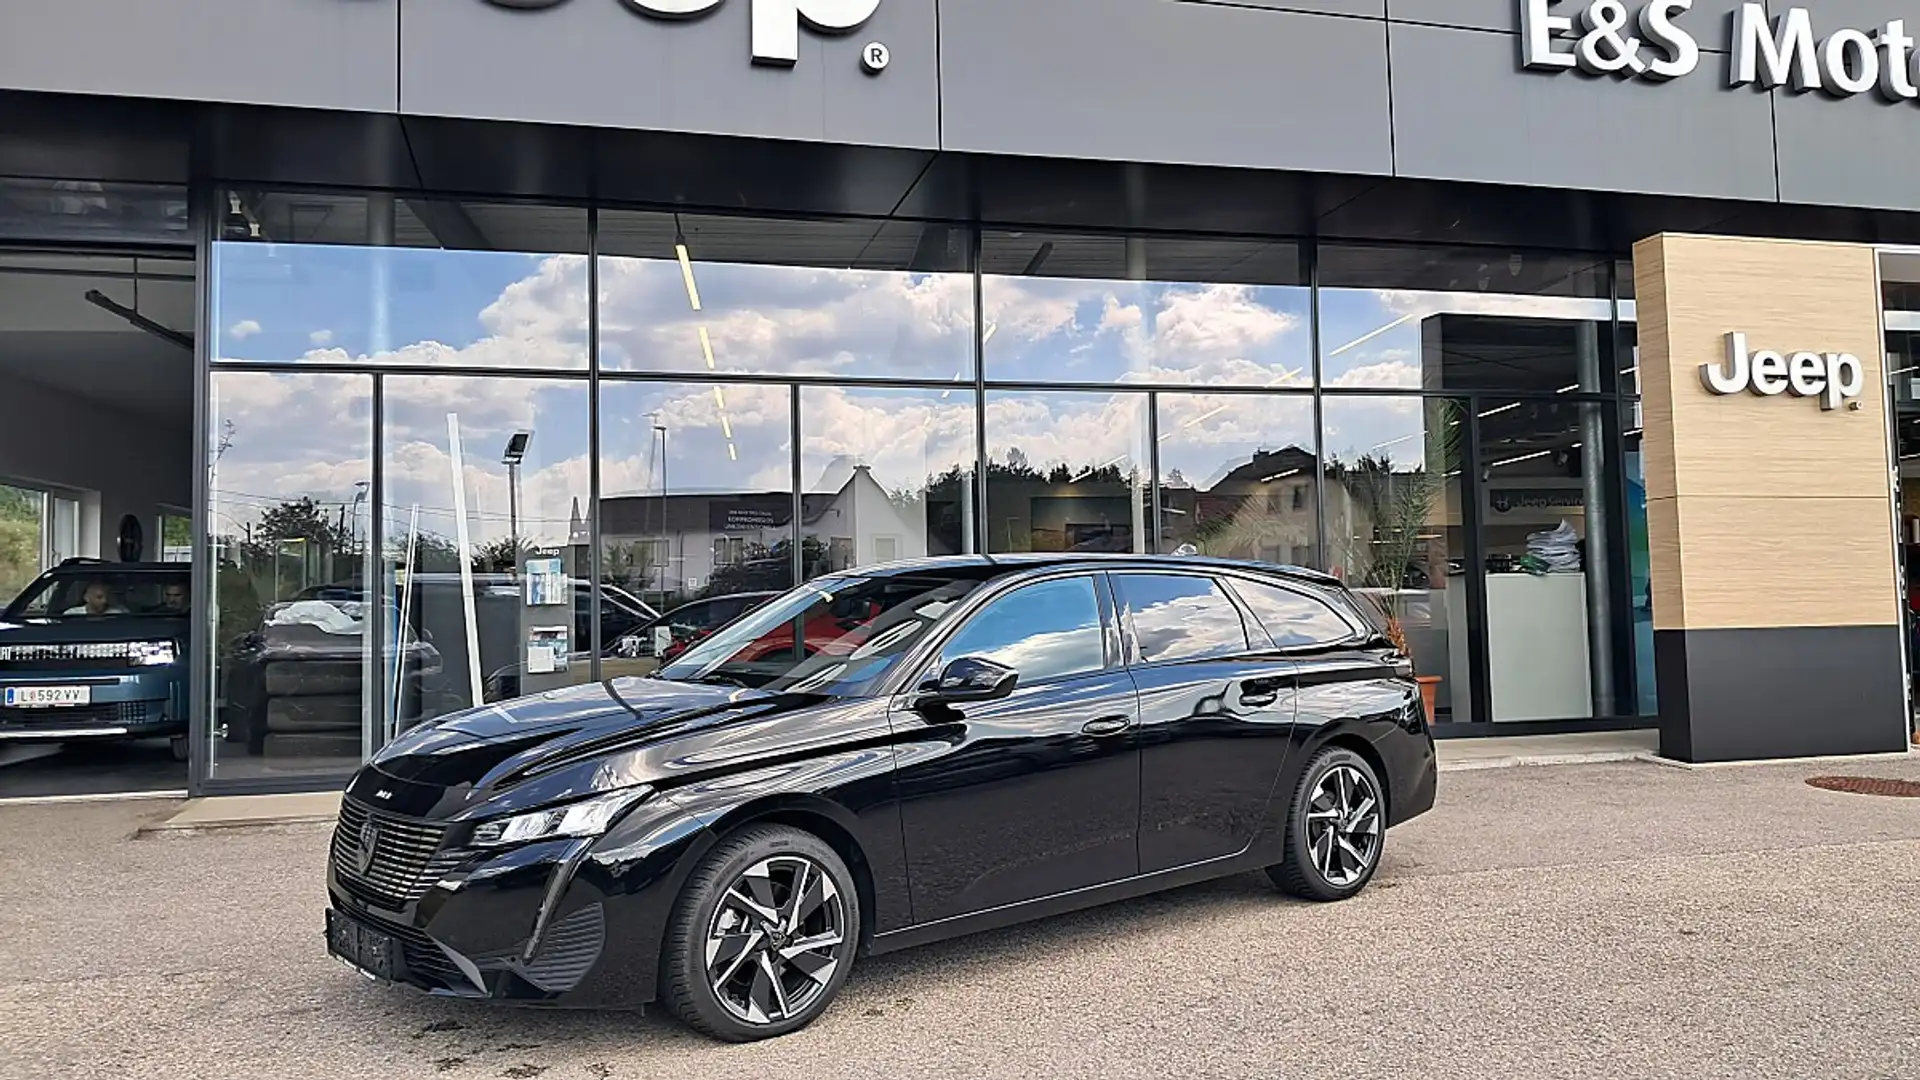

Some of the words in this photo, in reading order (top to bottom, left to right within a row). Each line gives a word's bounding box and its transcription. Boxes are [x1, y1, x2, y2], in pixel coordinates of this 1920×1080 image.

[1521, 0, 1700, 80] E&S
[1728, 1, 1920, 101] Mot
[1698, 331, 1864, 411] Jeep
